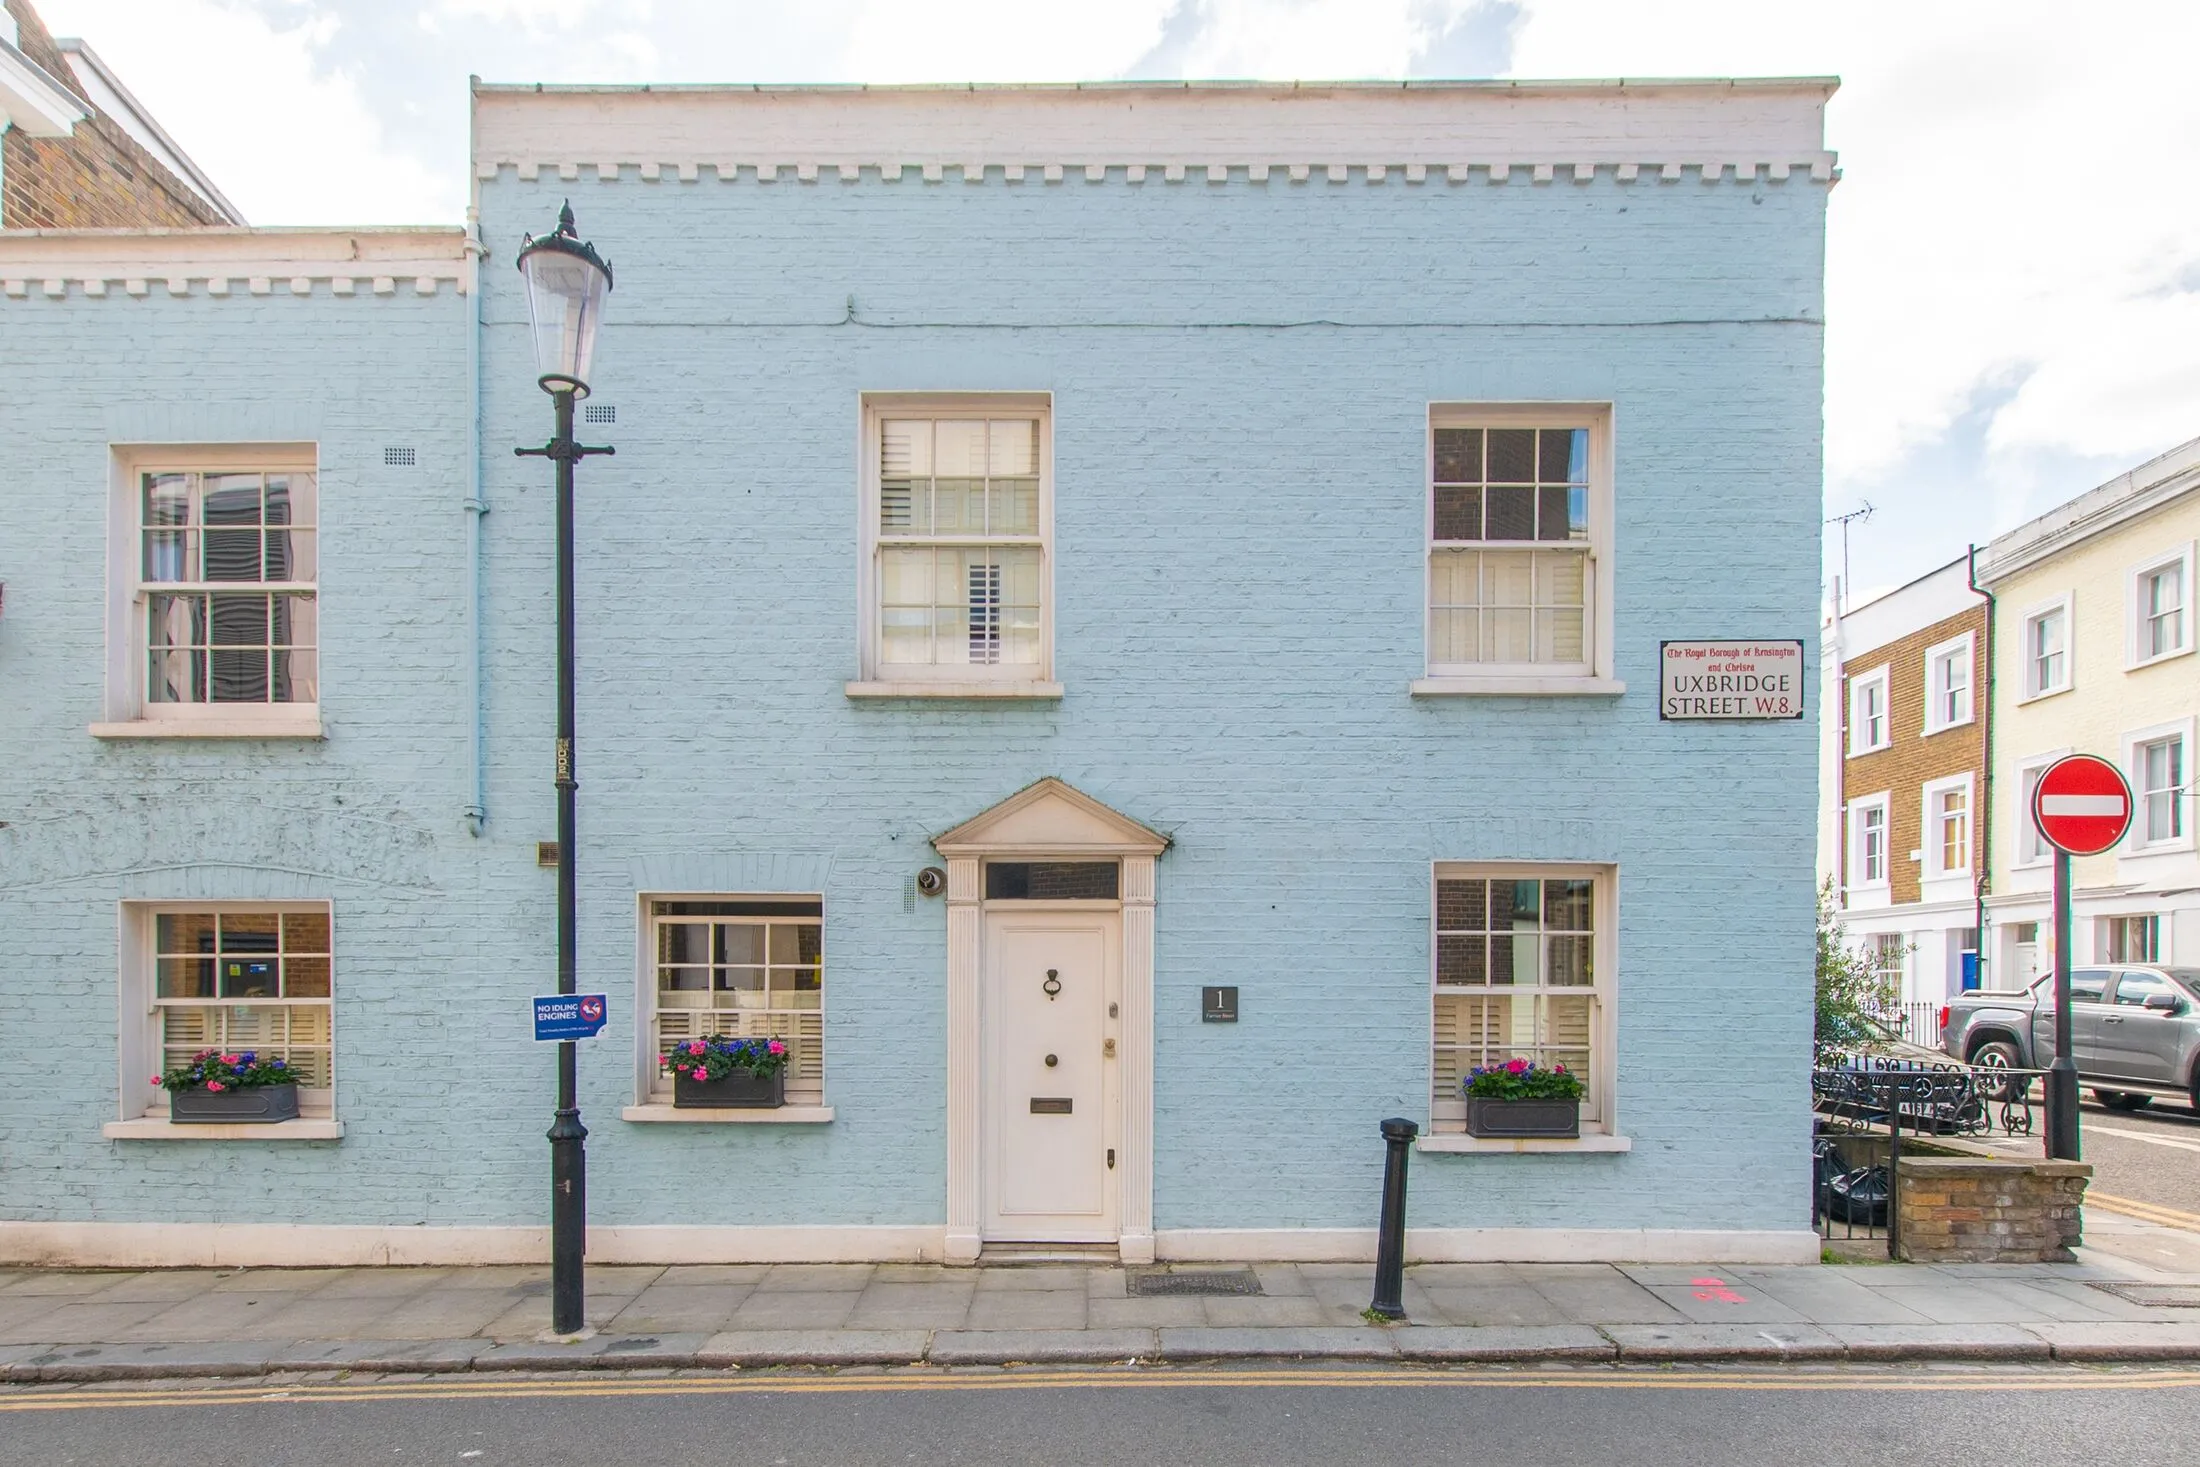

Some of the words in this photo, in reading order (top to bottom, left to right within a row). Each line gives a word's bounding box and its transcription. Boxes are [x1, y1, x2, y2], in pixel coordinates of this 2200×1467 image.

[1667, 649, 1682, 658] The
[1684, 648, 1706, 660] Royal
[1710, 648, 1740, 660] Borough
[1744, 647, 1752, 657] of
[1754, 646, 1795, 659] Kensington
[1708, 663, 1721, 672] and
[1725, 662, 1755, 672] Chelsea
[1674, 675, 1790, 692] UXBRIDGE
[1755, 696, 1794, 714] W.8.
[1216, 990, 1225, 1009] 1
[537, 1005, 551, 1013] NO
[552, 1003, 578, 1012] IDLING
[538, 1011, 577, 1021] ENGINES
